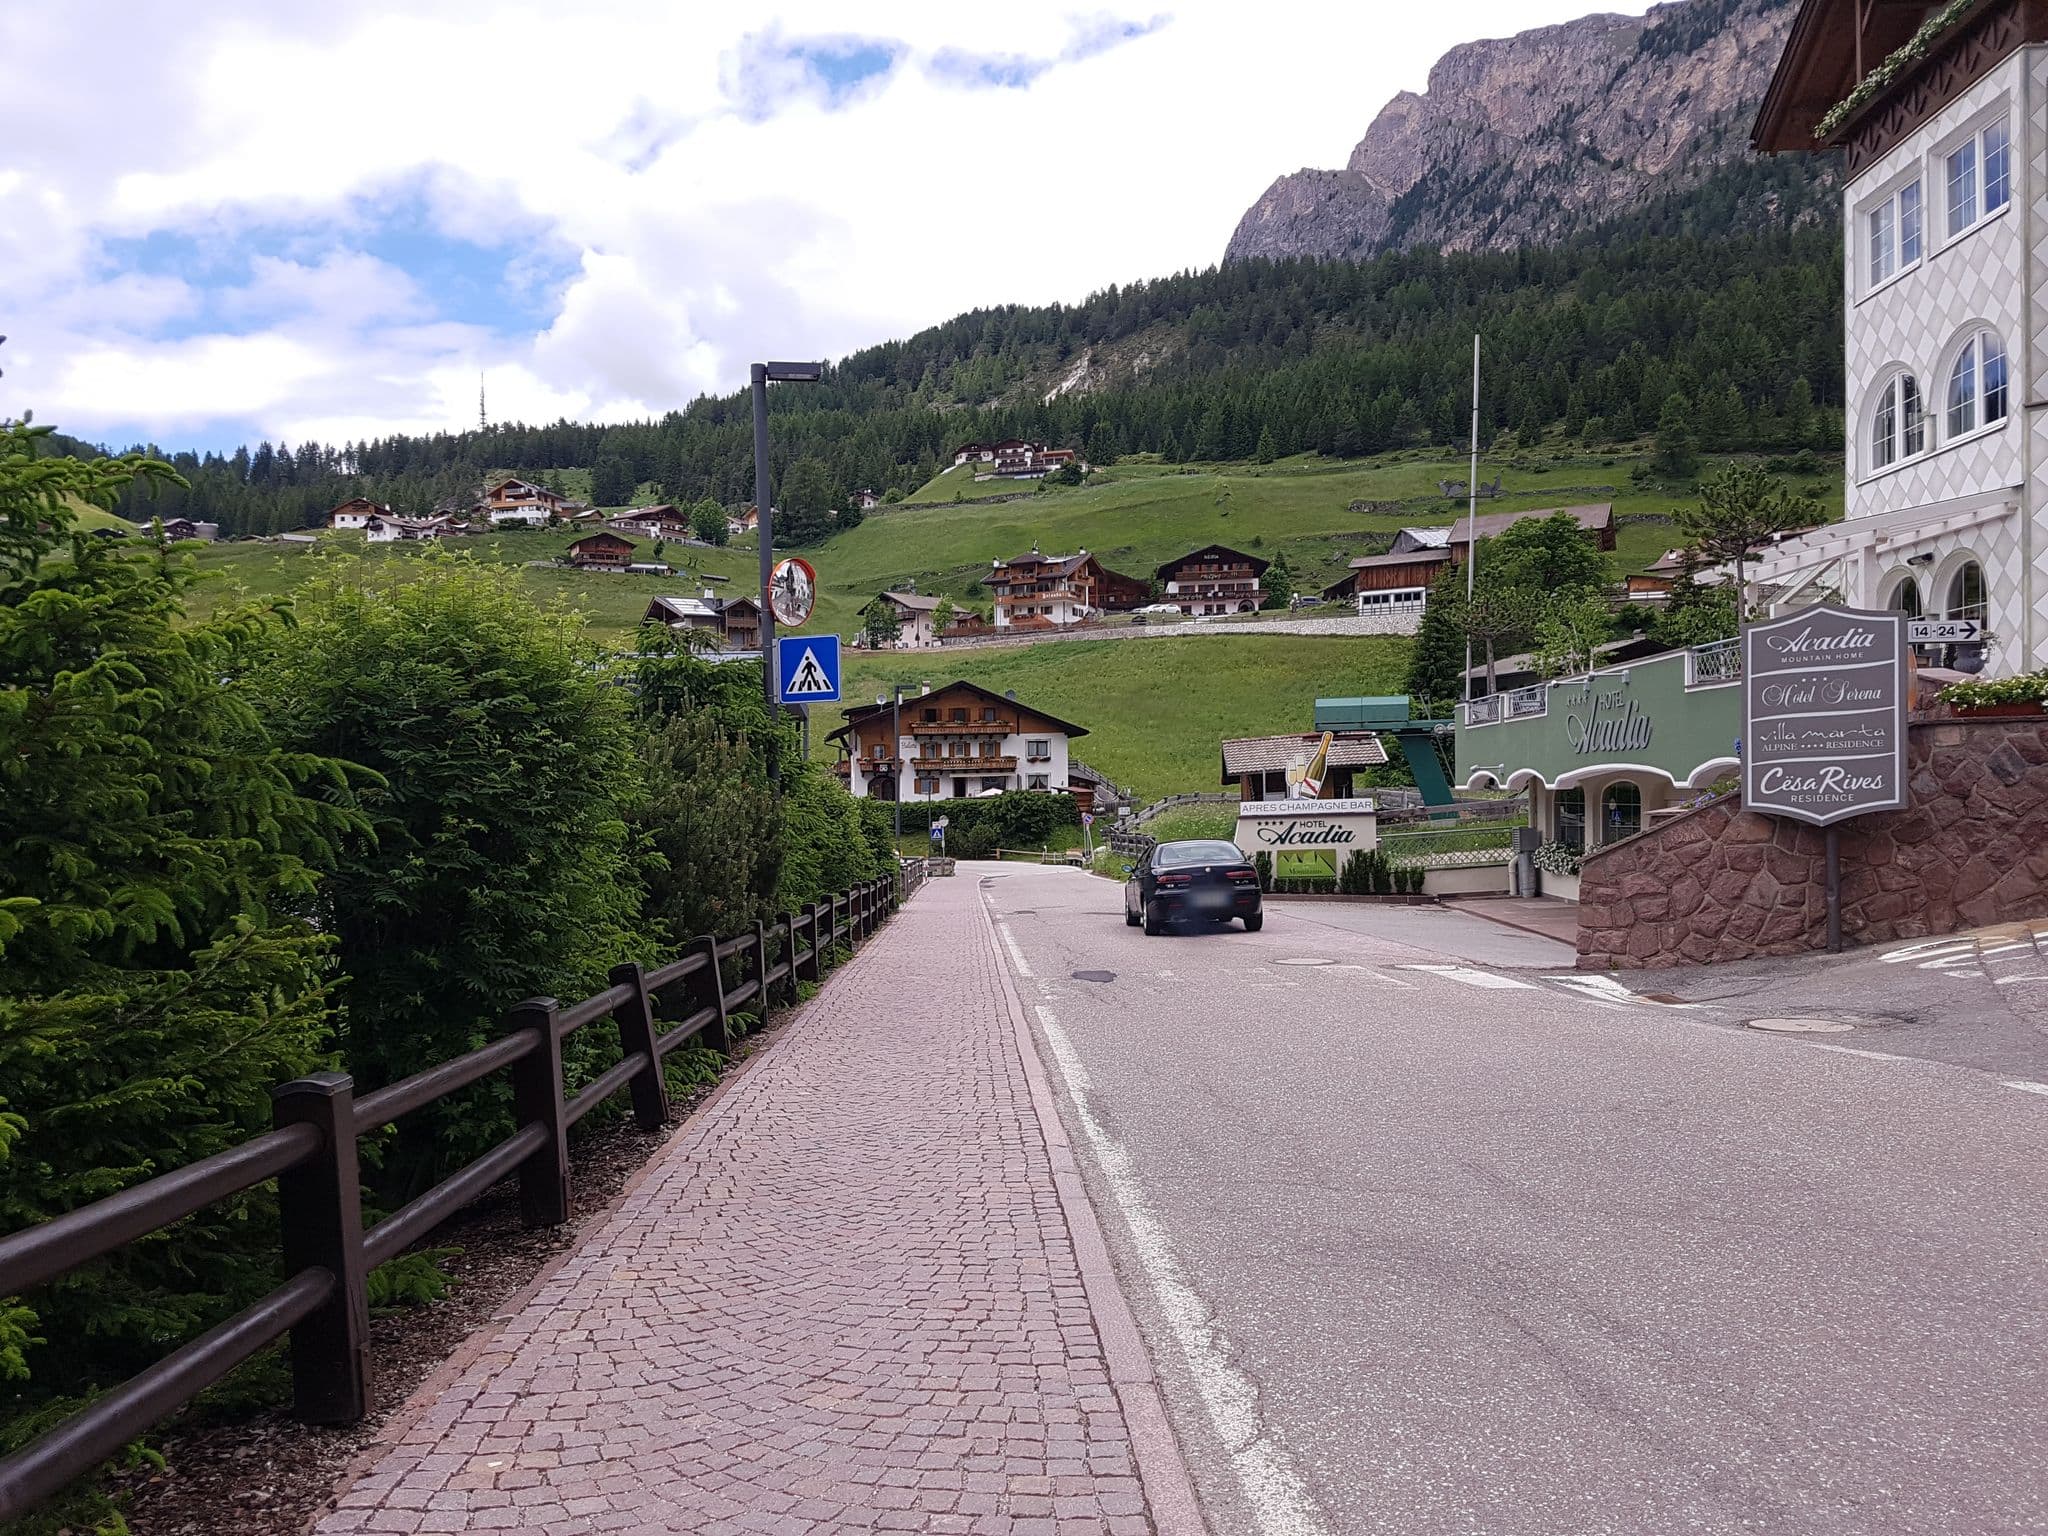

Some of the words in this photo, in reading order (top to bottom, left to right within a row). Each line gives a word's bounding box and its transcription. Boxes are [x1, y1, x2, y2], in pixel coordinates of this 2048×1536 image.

[1767, 627, 1876, 653] Acadia
[1781, 654, 1831, 663] MOUNTAIN
[1600, 690, 1625, 711] HOTEL
[1761, 684, 1816, 708] Hotel
[1821, 679, 1882, 704] Serena
[1567, 694, 1653, 754] Acadia
[1760, 722, 1796, 740] villa
[1801, 724, 1885, 739] marta
[1762, 743, 1797, 751] ALPINE
[1826, 739, 1884, 749] RESIDENCE
[1760, 767, 1818, 794] Cësa
[1819, 766, 1885, 793] Rives
[1279, 801, 1348, 811] CHAMPAGNE
[1350, 801, 1372, 809] BAR
[1791, 794, 1854, 802] RESIDENCE
[1257, 821, 1356, 845] Acadia
